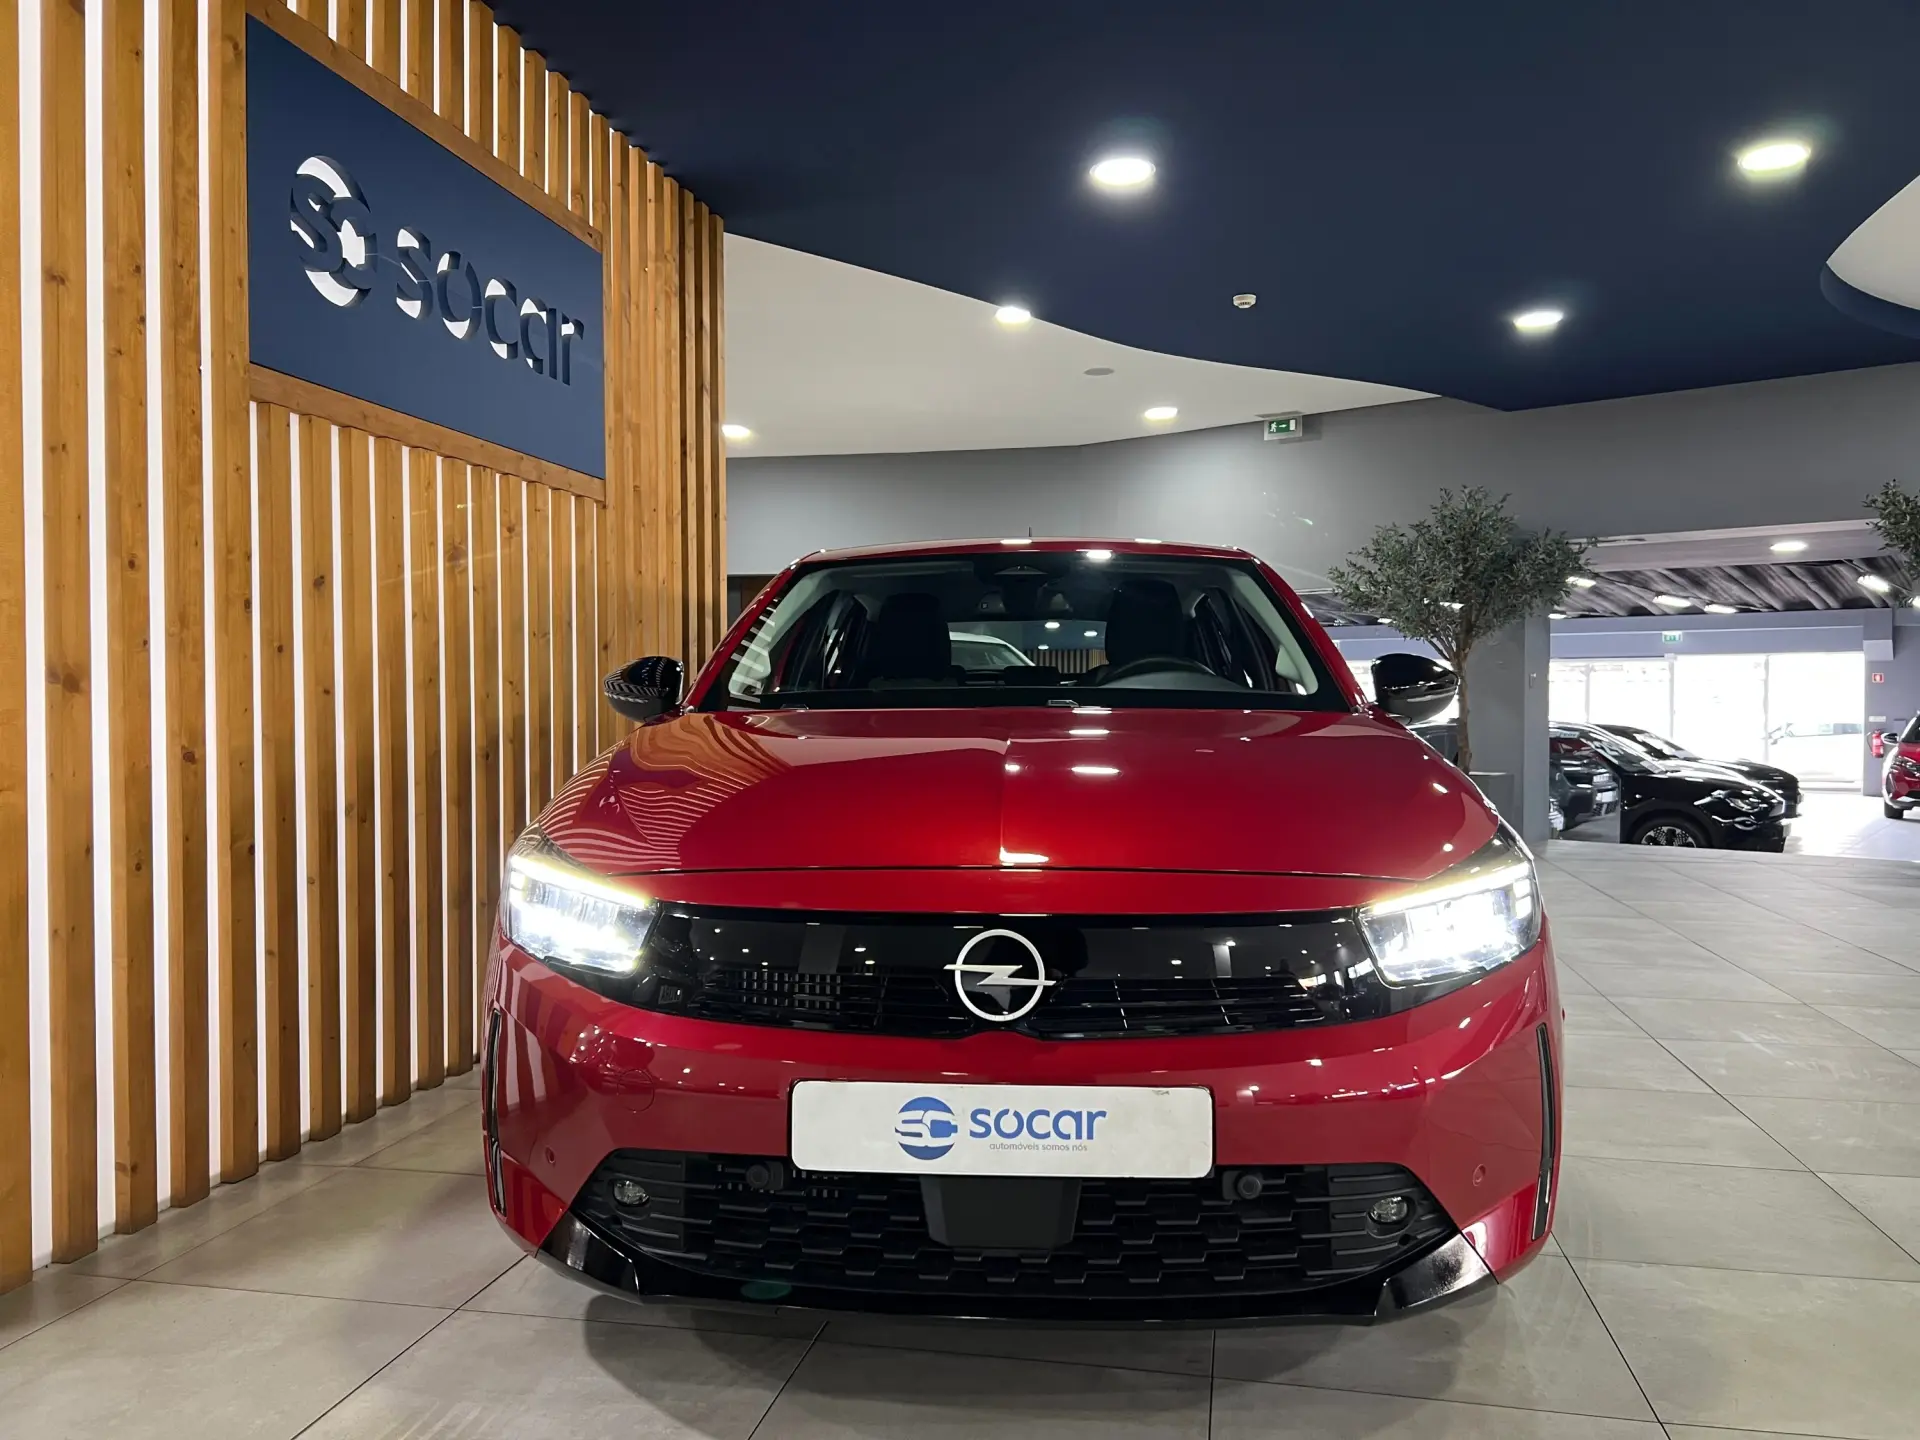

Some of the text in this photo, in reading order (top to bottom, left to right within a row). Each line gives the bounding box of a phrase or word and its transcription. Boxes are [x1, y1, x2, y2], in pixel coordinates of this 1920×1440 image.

[396, 226, 584, 386] socar
[969, 1108, 1107, 1140] socar
[989, 1141, 1088, 1152] automóveis somos nós
